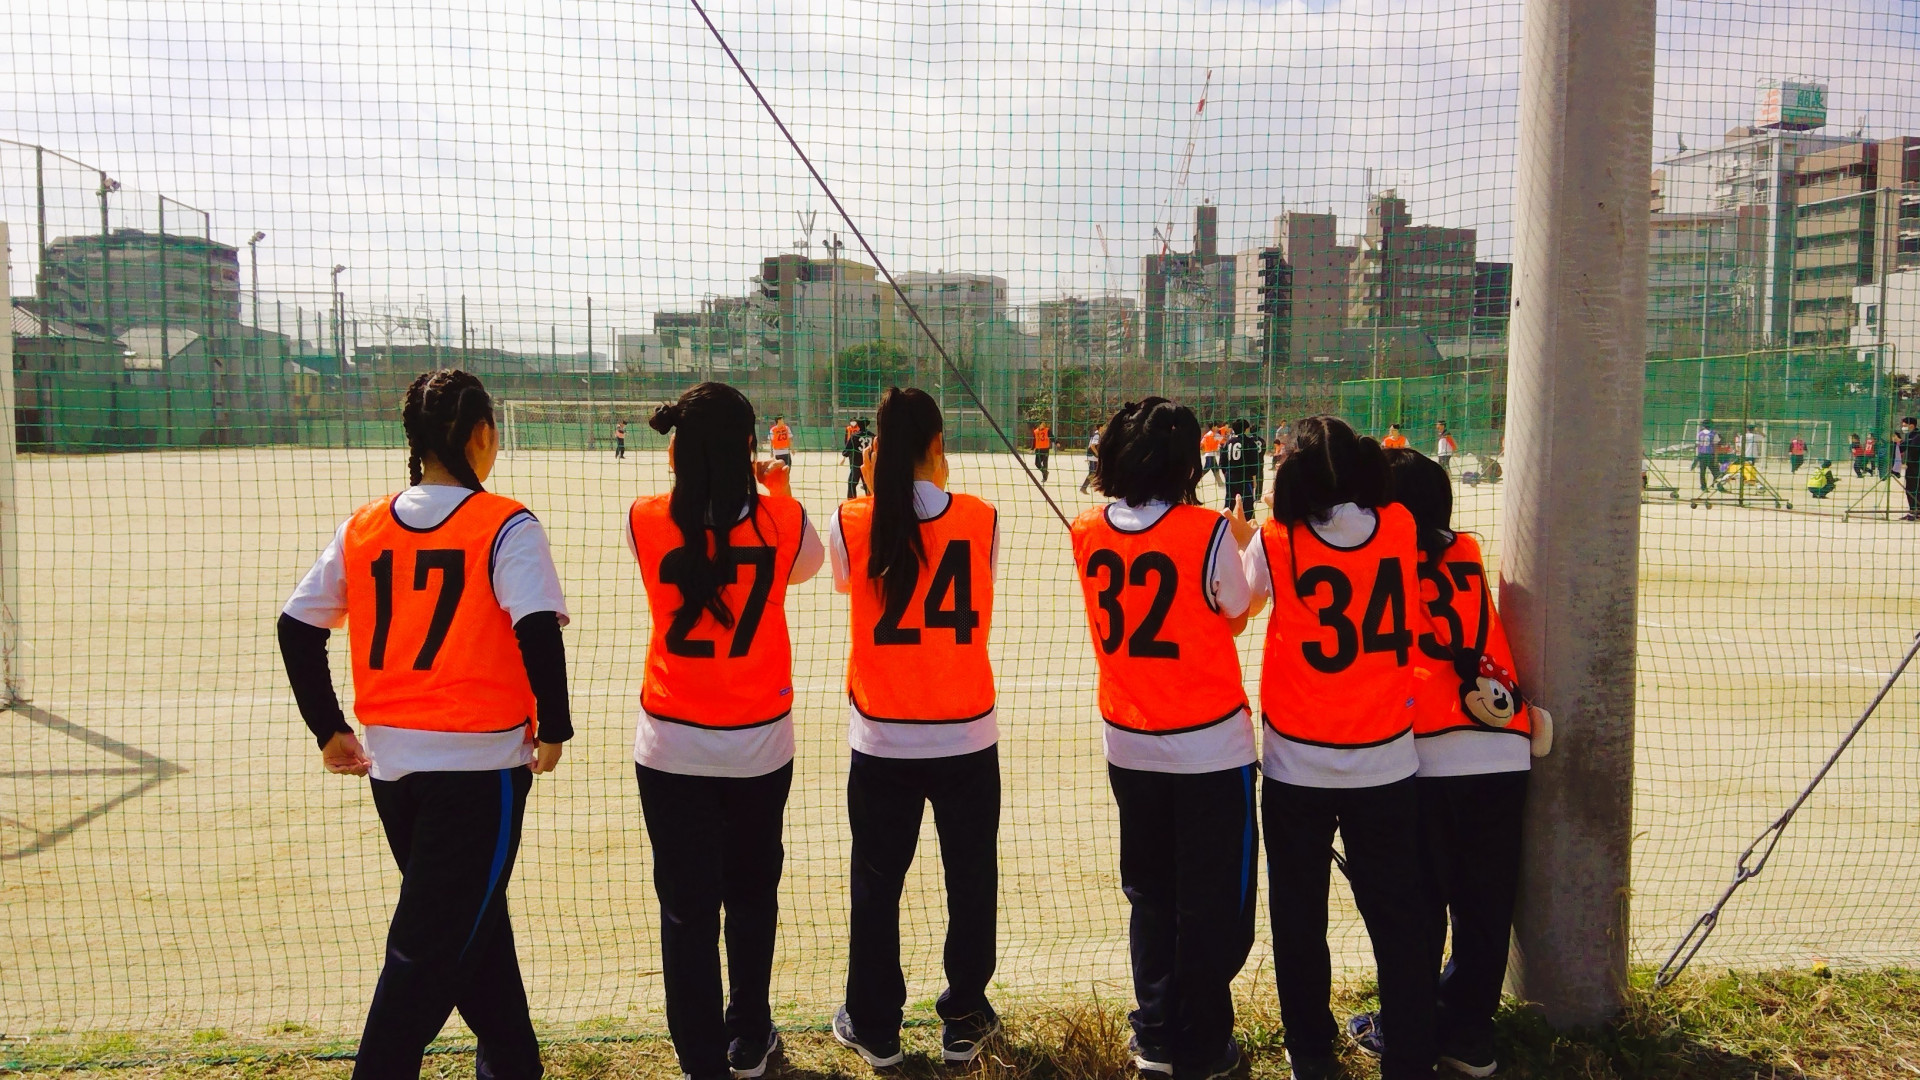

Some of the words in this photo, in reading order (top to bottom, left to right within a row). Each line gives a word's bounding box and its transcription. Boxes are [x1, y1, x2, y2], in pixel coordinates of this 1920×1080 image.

[1228, 442, 1242, 461] 16
[368, 549, 466, 672] 17
[659, 546, 777, 659] 27
[872, 540, 980, 646] 24
[1086, 548, 1180, 661] 32
[1298, 557, 1414, 674] 34
[1417, 560, 1490, 660] 37
